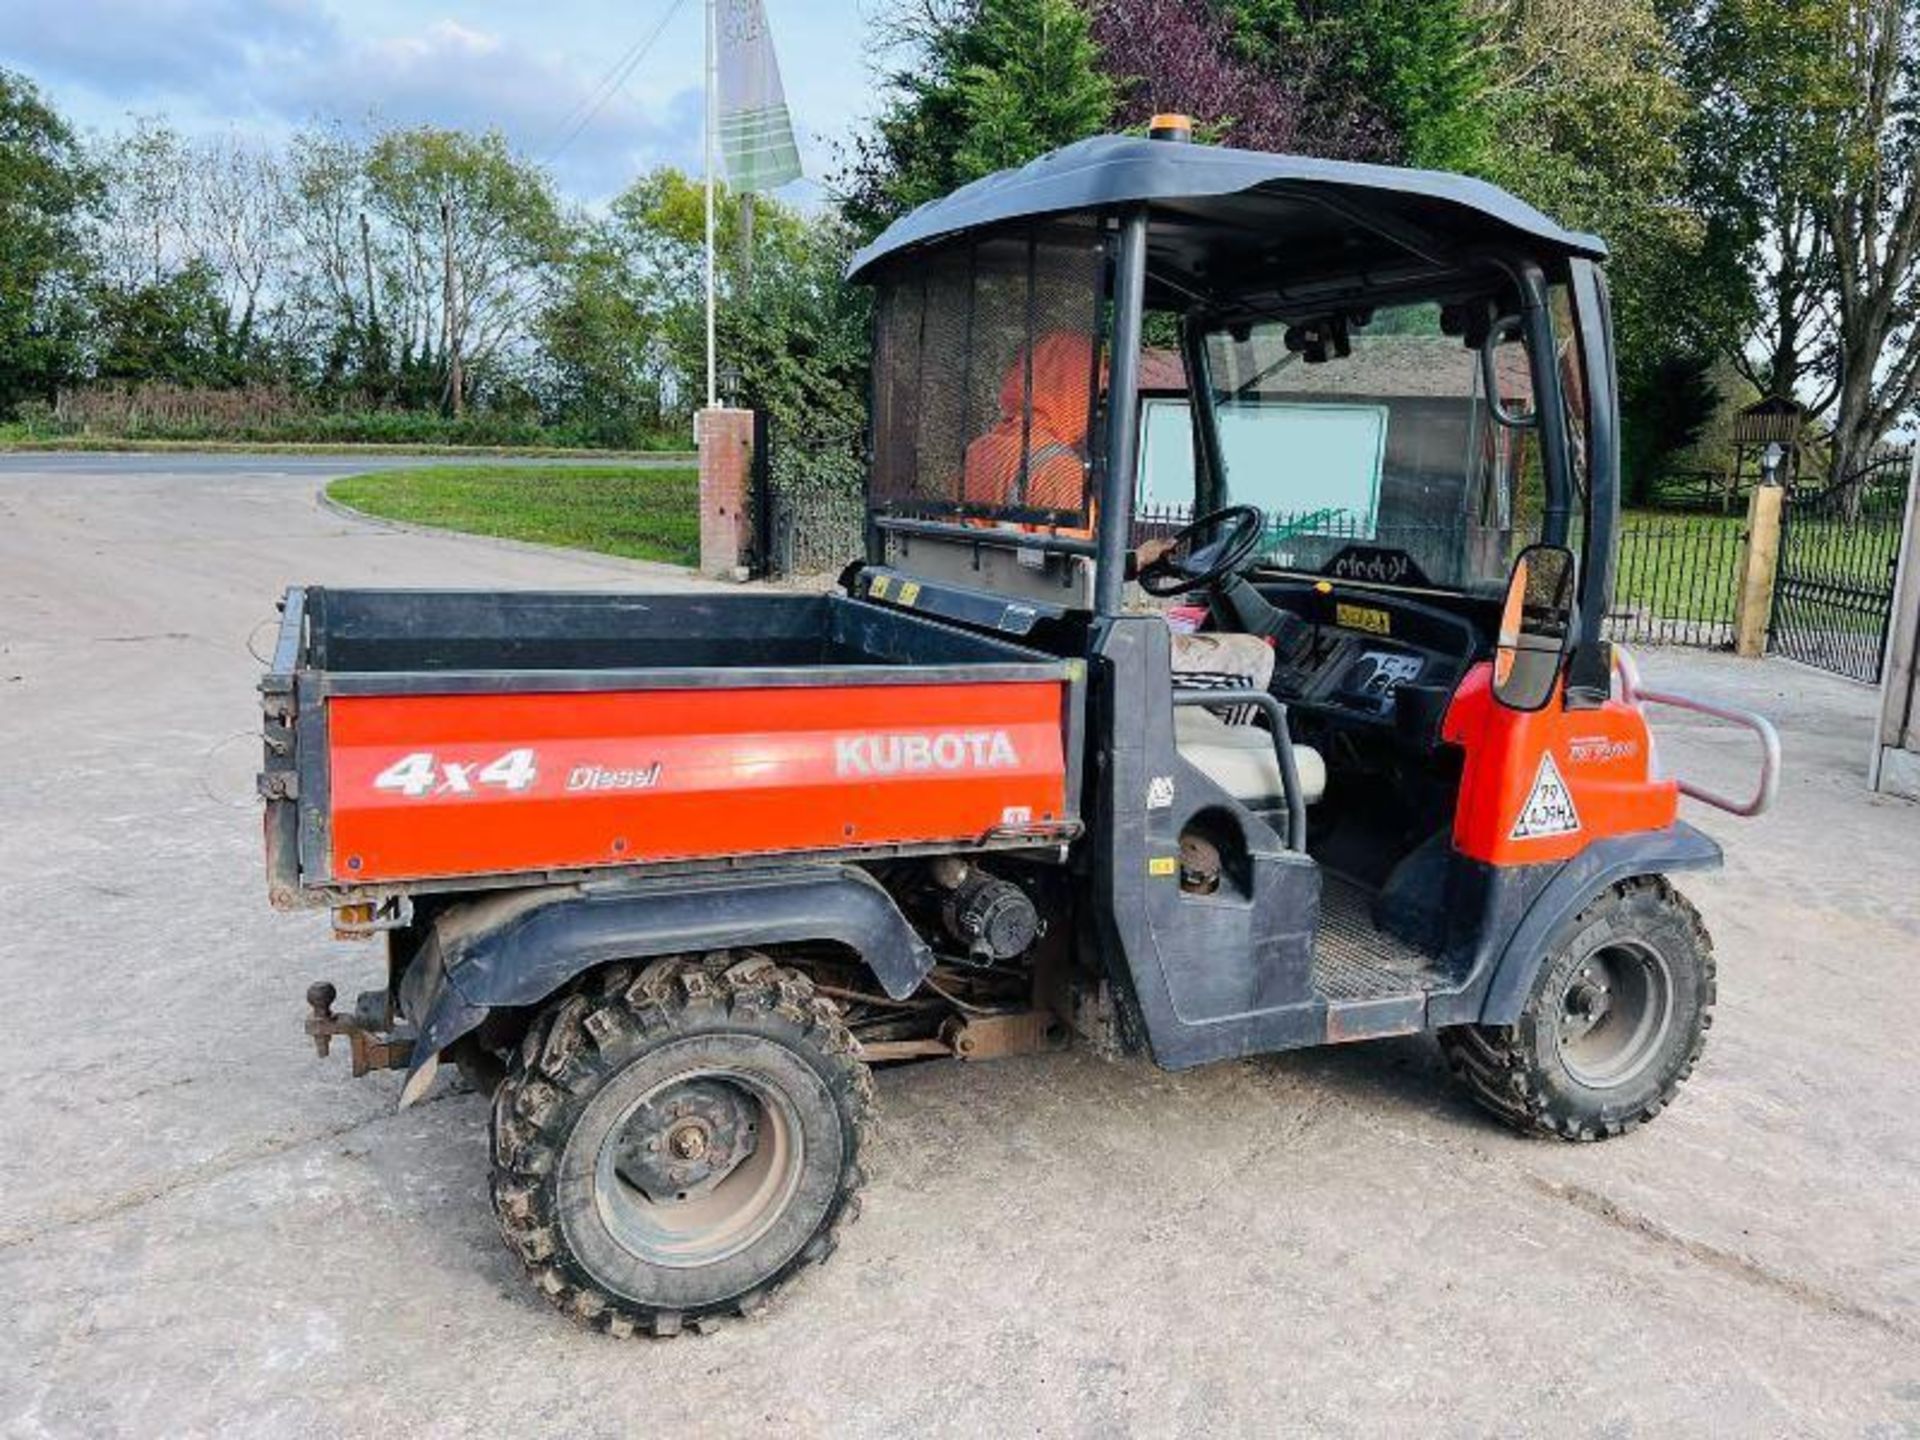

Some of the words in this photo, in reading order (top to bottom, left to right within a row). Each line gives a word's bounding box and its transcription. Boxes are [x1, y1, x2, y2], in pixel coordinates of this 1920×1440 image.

[373, 747, 538, 797] 4x4
[566, 762, 661, 791] Diesel
[835, 730, 1019, 777] KUBOTA
